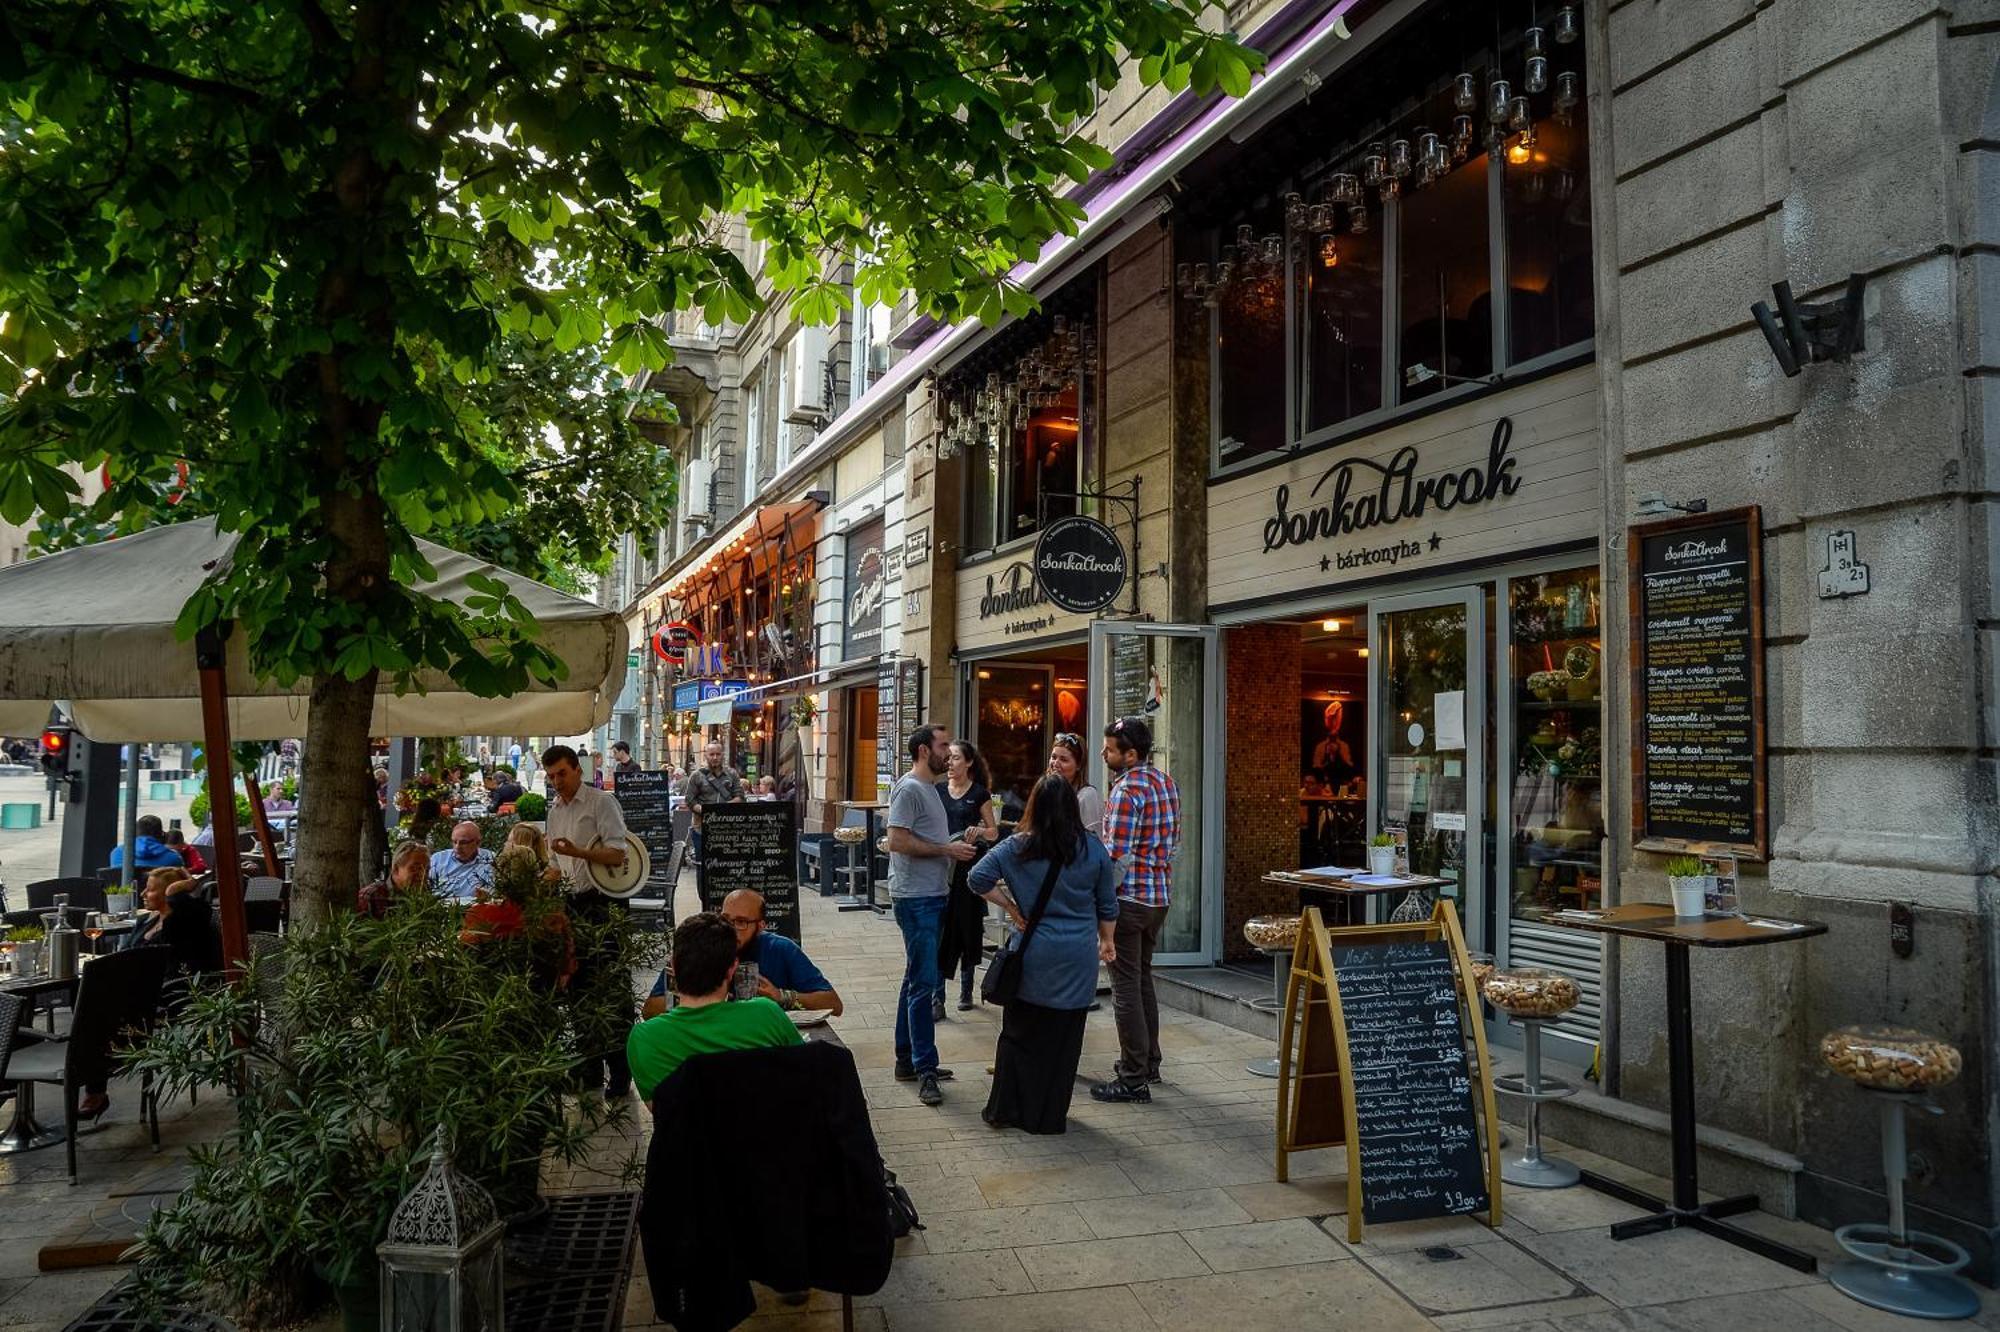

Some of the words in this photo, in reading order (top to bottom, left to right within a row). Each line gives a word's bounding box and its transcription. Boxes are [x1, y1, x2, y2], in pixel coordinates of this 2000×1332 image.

[1263, 416, 1522, 554] SonkaArcok
[1039, 551, 1123, 573] SonkaArcok
[1336, 540, 1421, 570] bárkonyha
[1664, 537, 1728, 561] SonkaArcok
